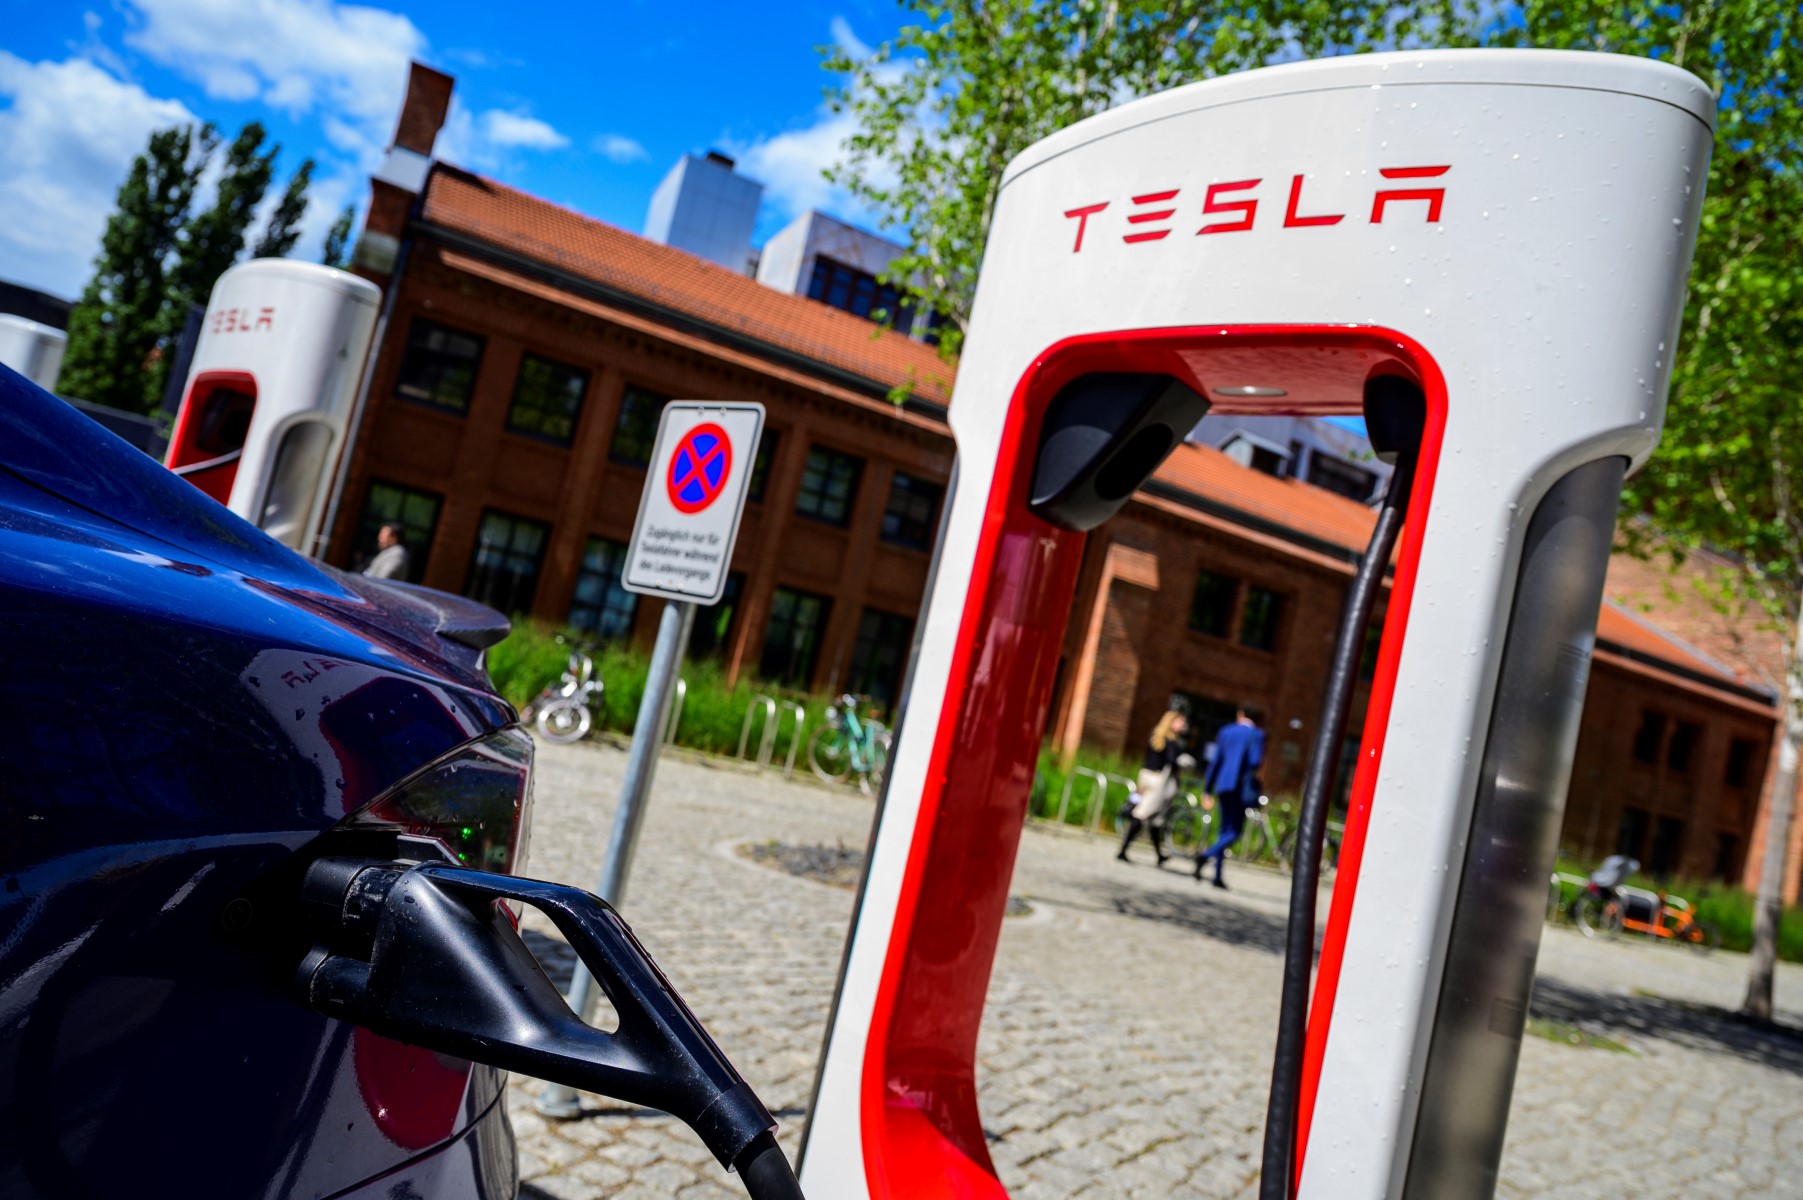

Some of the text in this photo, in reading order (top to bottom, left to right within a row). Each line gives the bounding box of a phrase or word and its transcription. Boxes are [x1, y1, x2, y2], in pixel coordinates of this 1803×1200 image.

[1064, 165, 1452, 253] TESLA
[692, 533, 705, 544] nur
[708, 532, 719, 545] für
